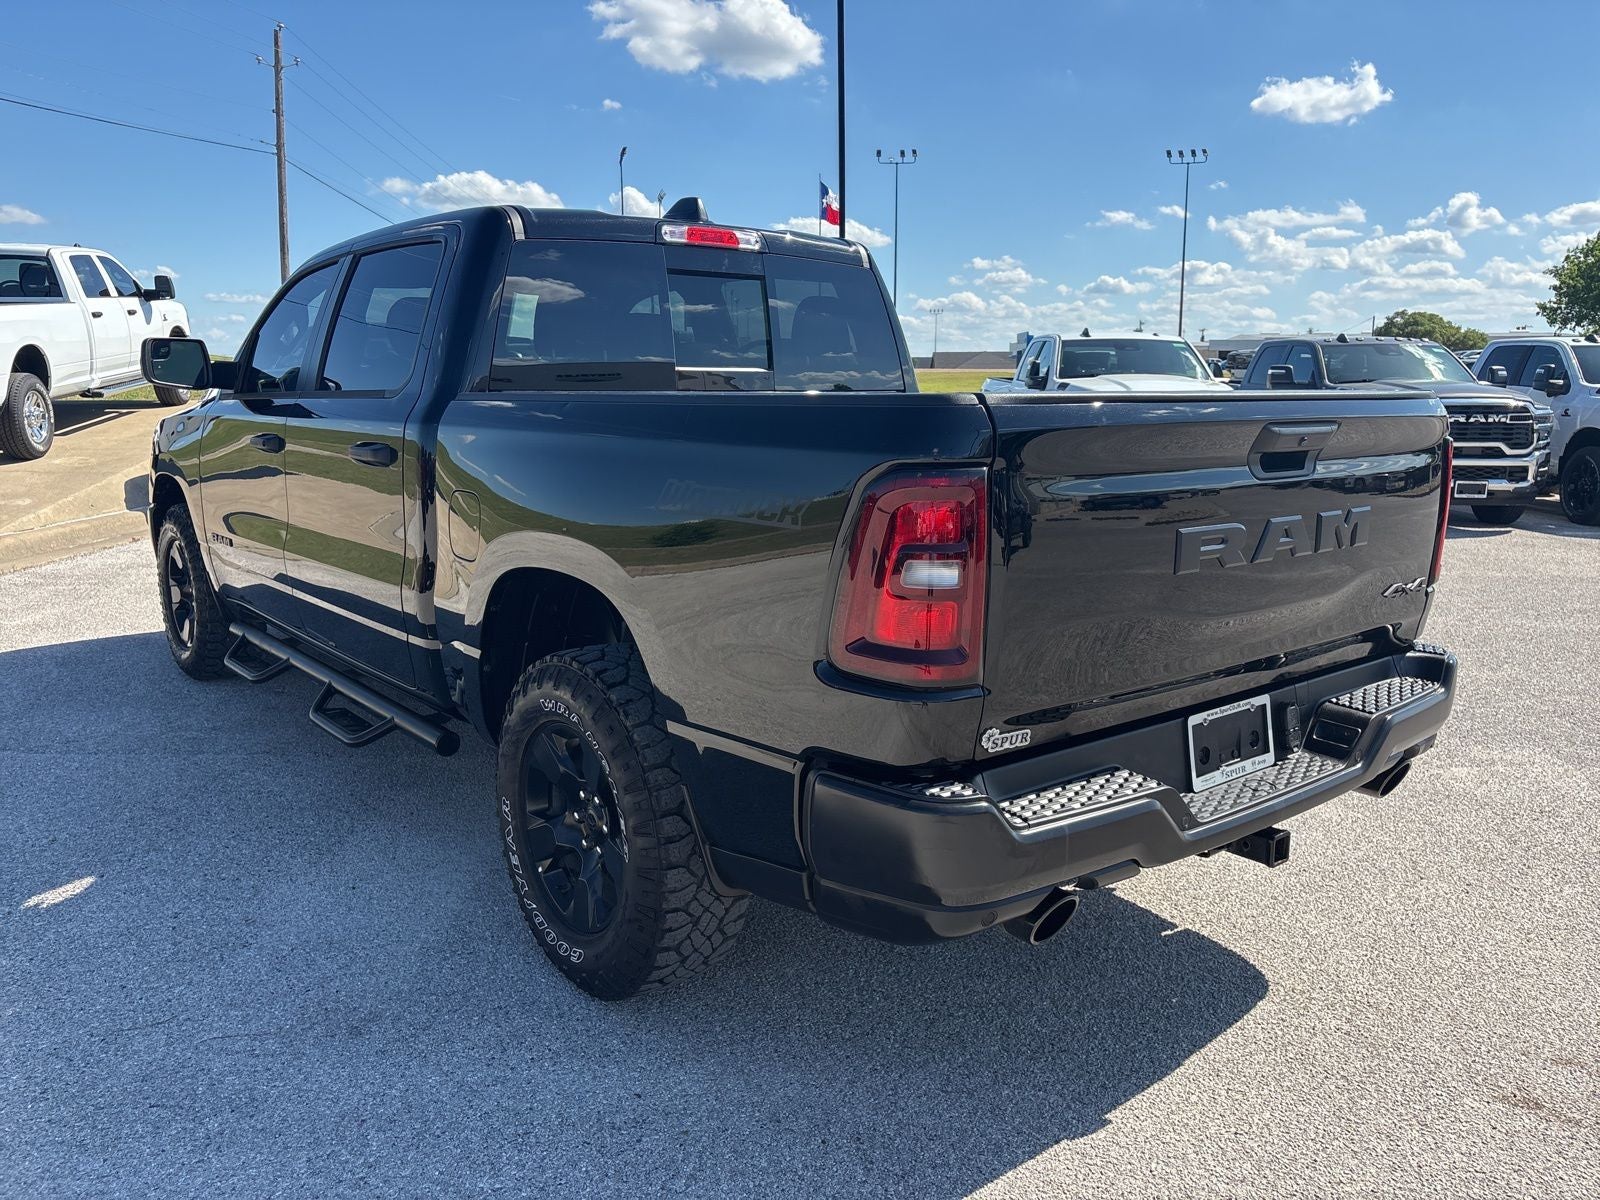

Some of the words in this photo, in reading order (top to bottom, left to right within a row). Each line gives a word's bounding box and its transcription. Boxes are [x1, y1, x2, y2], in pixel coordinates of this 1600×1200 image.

[1449, 413, 1508, 423] RAM
[211, 532, 233, 547] RAM
[1174, 506, 1371, 574] RAM
[990, 732, 1029, 750] SPUR
[1225, 765, 1247, 779] SPUR
[502, 796, 584, 963] GOODYEAR
